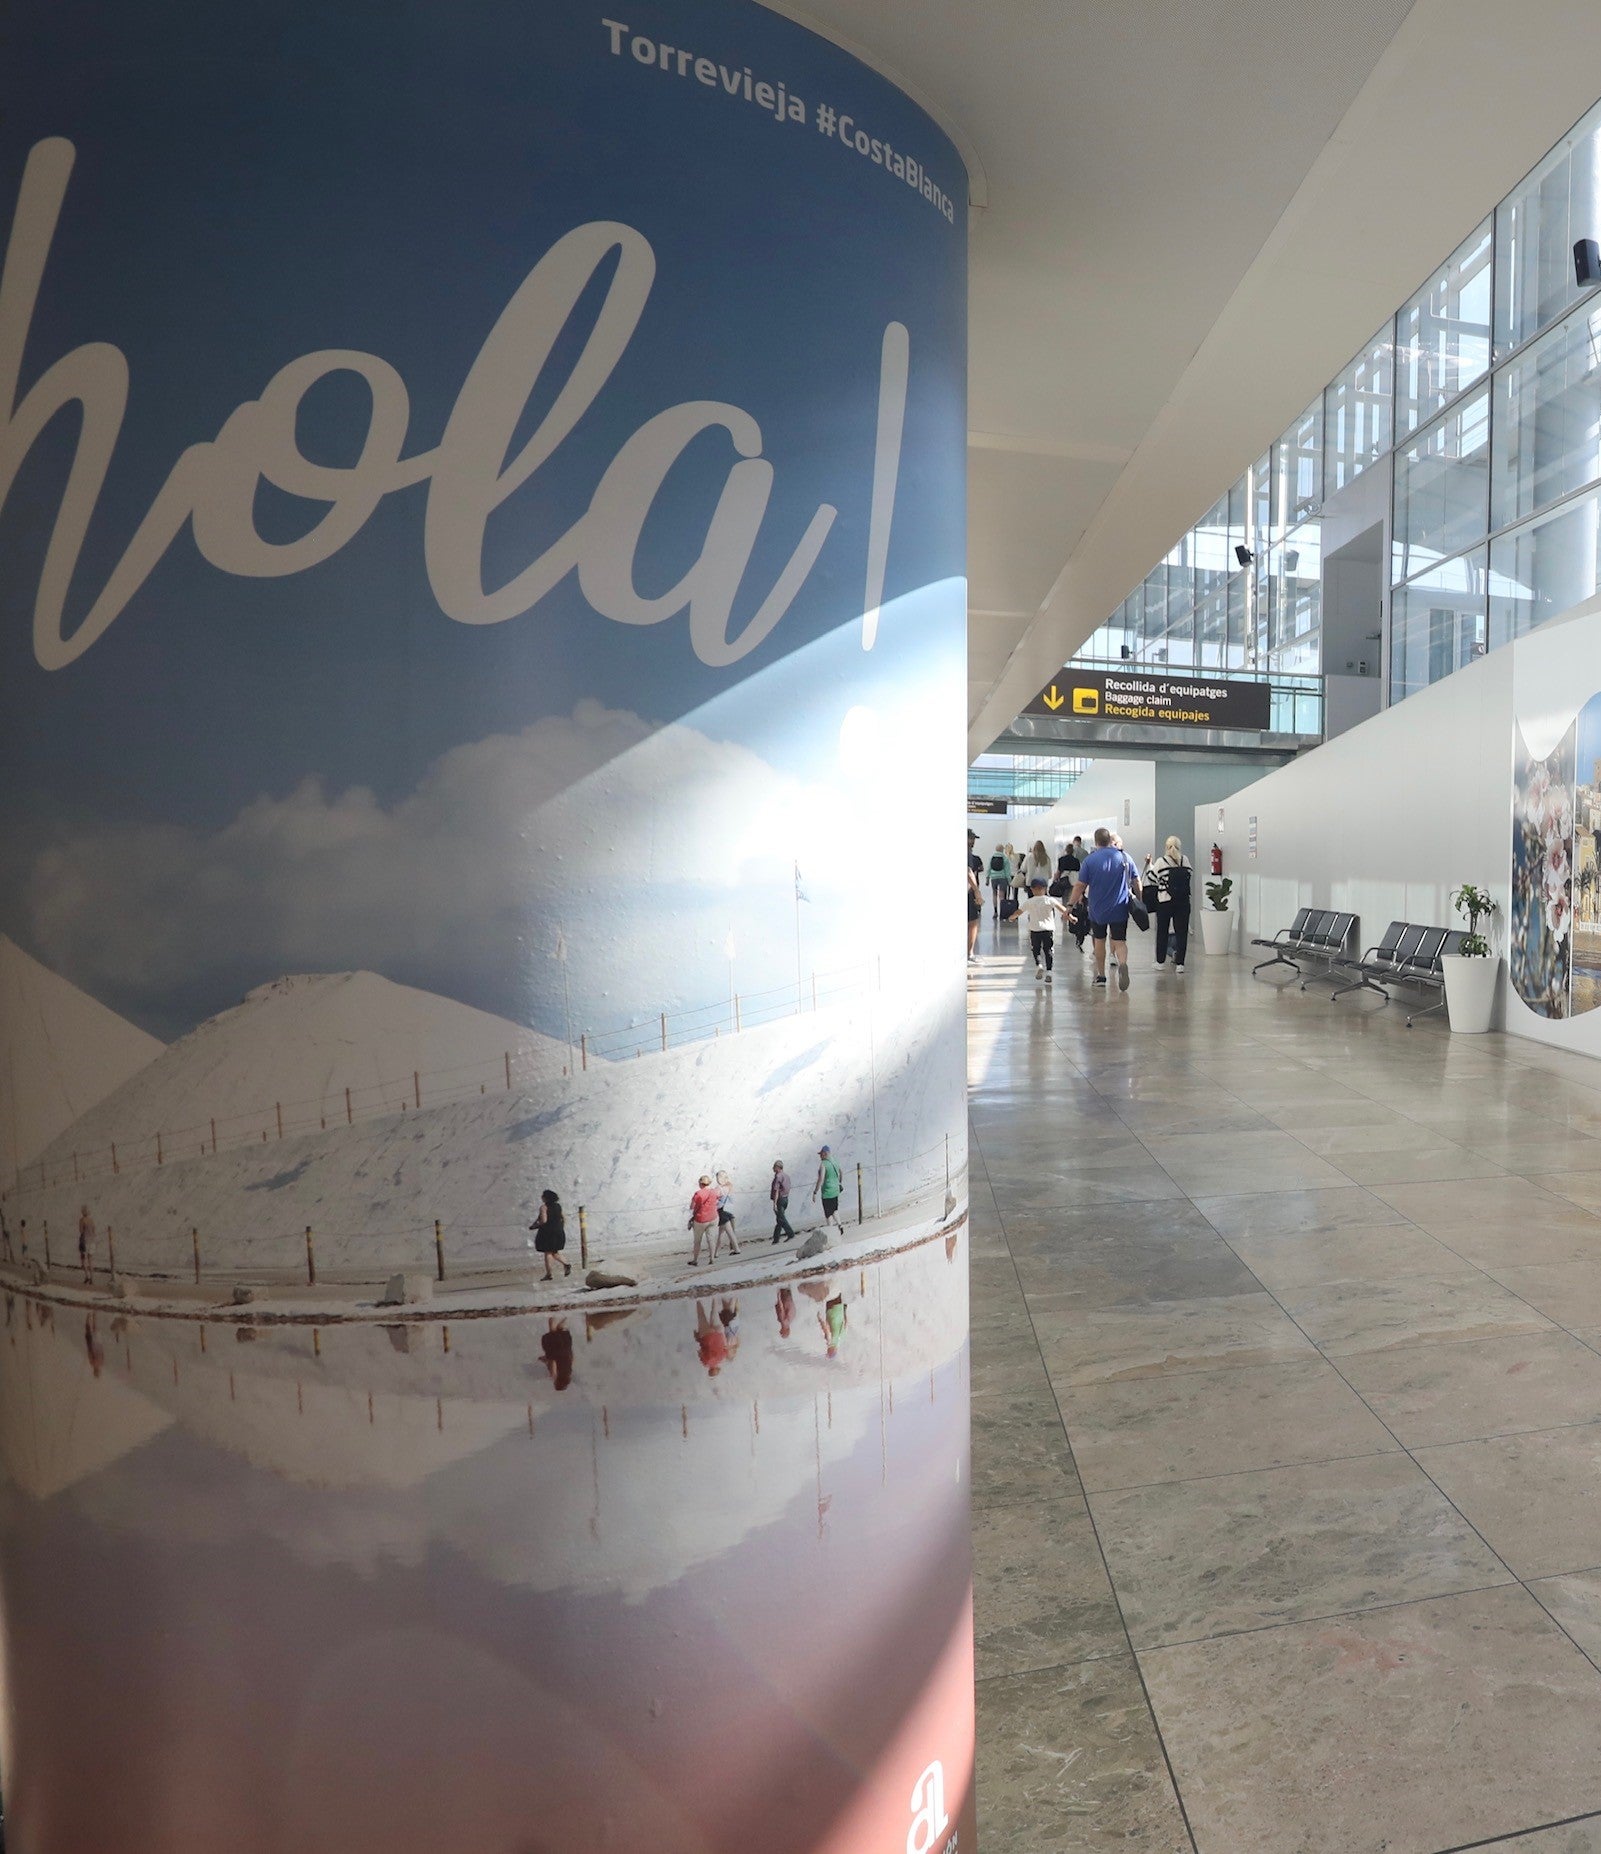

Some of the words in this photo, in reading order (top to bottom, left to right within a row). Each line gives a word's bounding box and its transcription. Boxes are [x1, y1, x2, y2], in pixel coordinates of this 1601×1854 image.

[602, 17, 806, 124] Torrevieja
[816, 103, 954, 225] #CostaBlanca
[1105, 678, 1156, 693] Recollida
[1104, 691, 1144, 706] Baggage
[1146, 694, 1172, 706] claim
[1104, 703, 1155, 719] Recogida
[1158, 709, 1210, 722] equipajes
